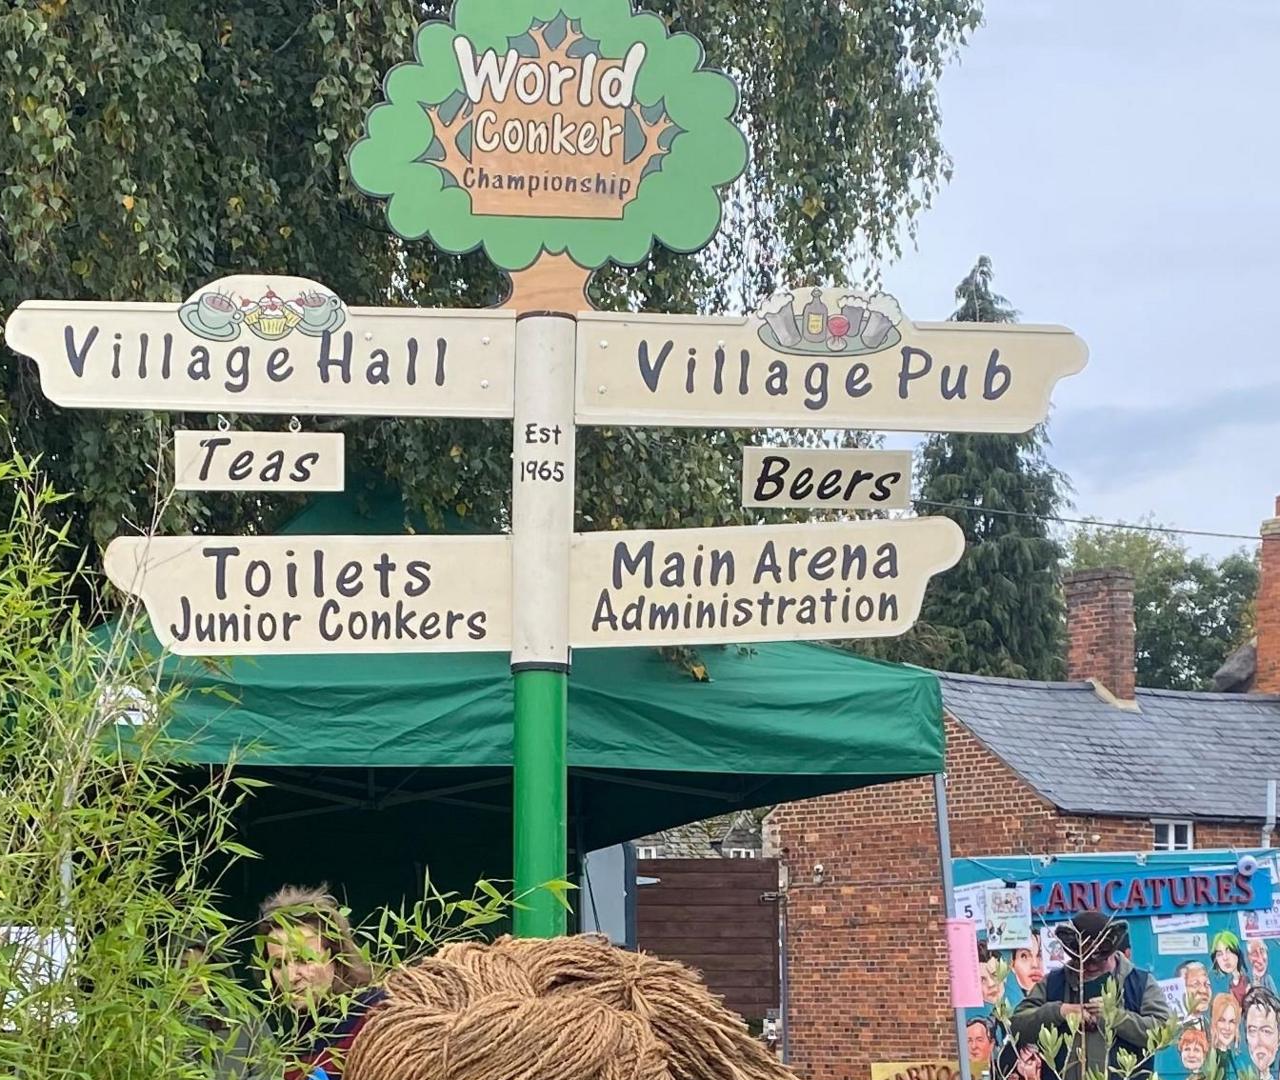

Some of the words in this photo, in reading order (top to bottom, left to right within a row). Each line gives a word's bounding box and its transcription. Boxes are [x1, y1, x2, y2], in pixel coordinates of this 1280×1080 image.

[453, 35, 647, 108] World
[474, 110, 623, 156] Conker
[462, 167, 631, 200] Championship
[63, 324, 295, 394] Village
[317, 329, 448, 387] Hall
[637, 339, 873, 411] Village
[898, 346, 1013, 401] Pub
[524, 423, 562, 445] Est
[197, 437, 320, 482] Teas
[520, 461, 565, 483] 1965
[752, 455, 902, 502] Beers
[202, 546, 432, 600] Toilets
[612, 540, 735, 590] Main
[752, 540, 899, 584] Arena
[170, 596, 302, 642] Junior
[319, 598, 488, 642] Conkers
[591, 587, 899, 632] Administration
[1030, 874, 1253, 914] CARICATURES
